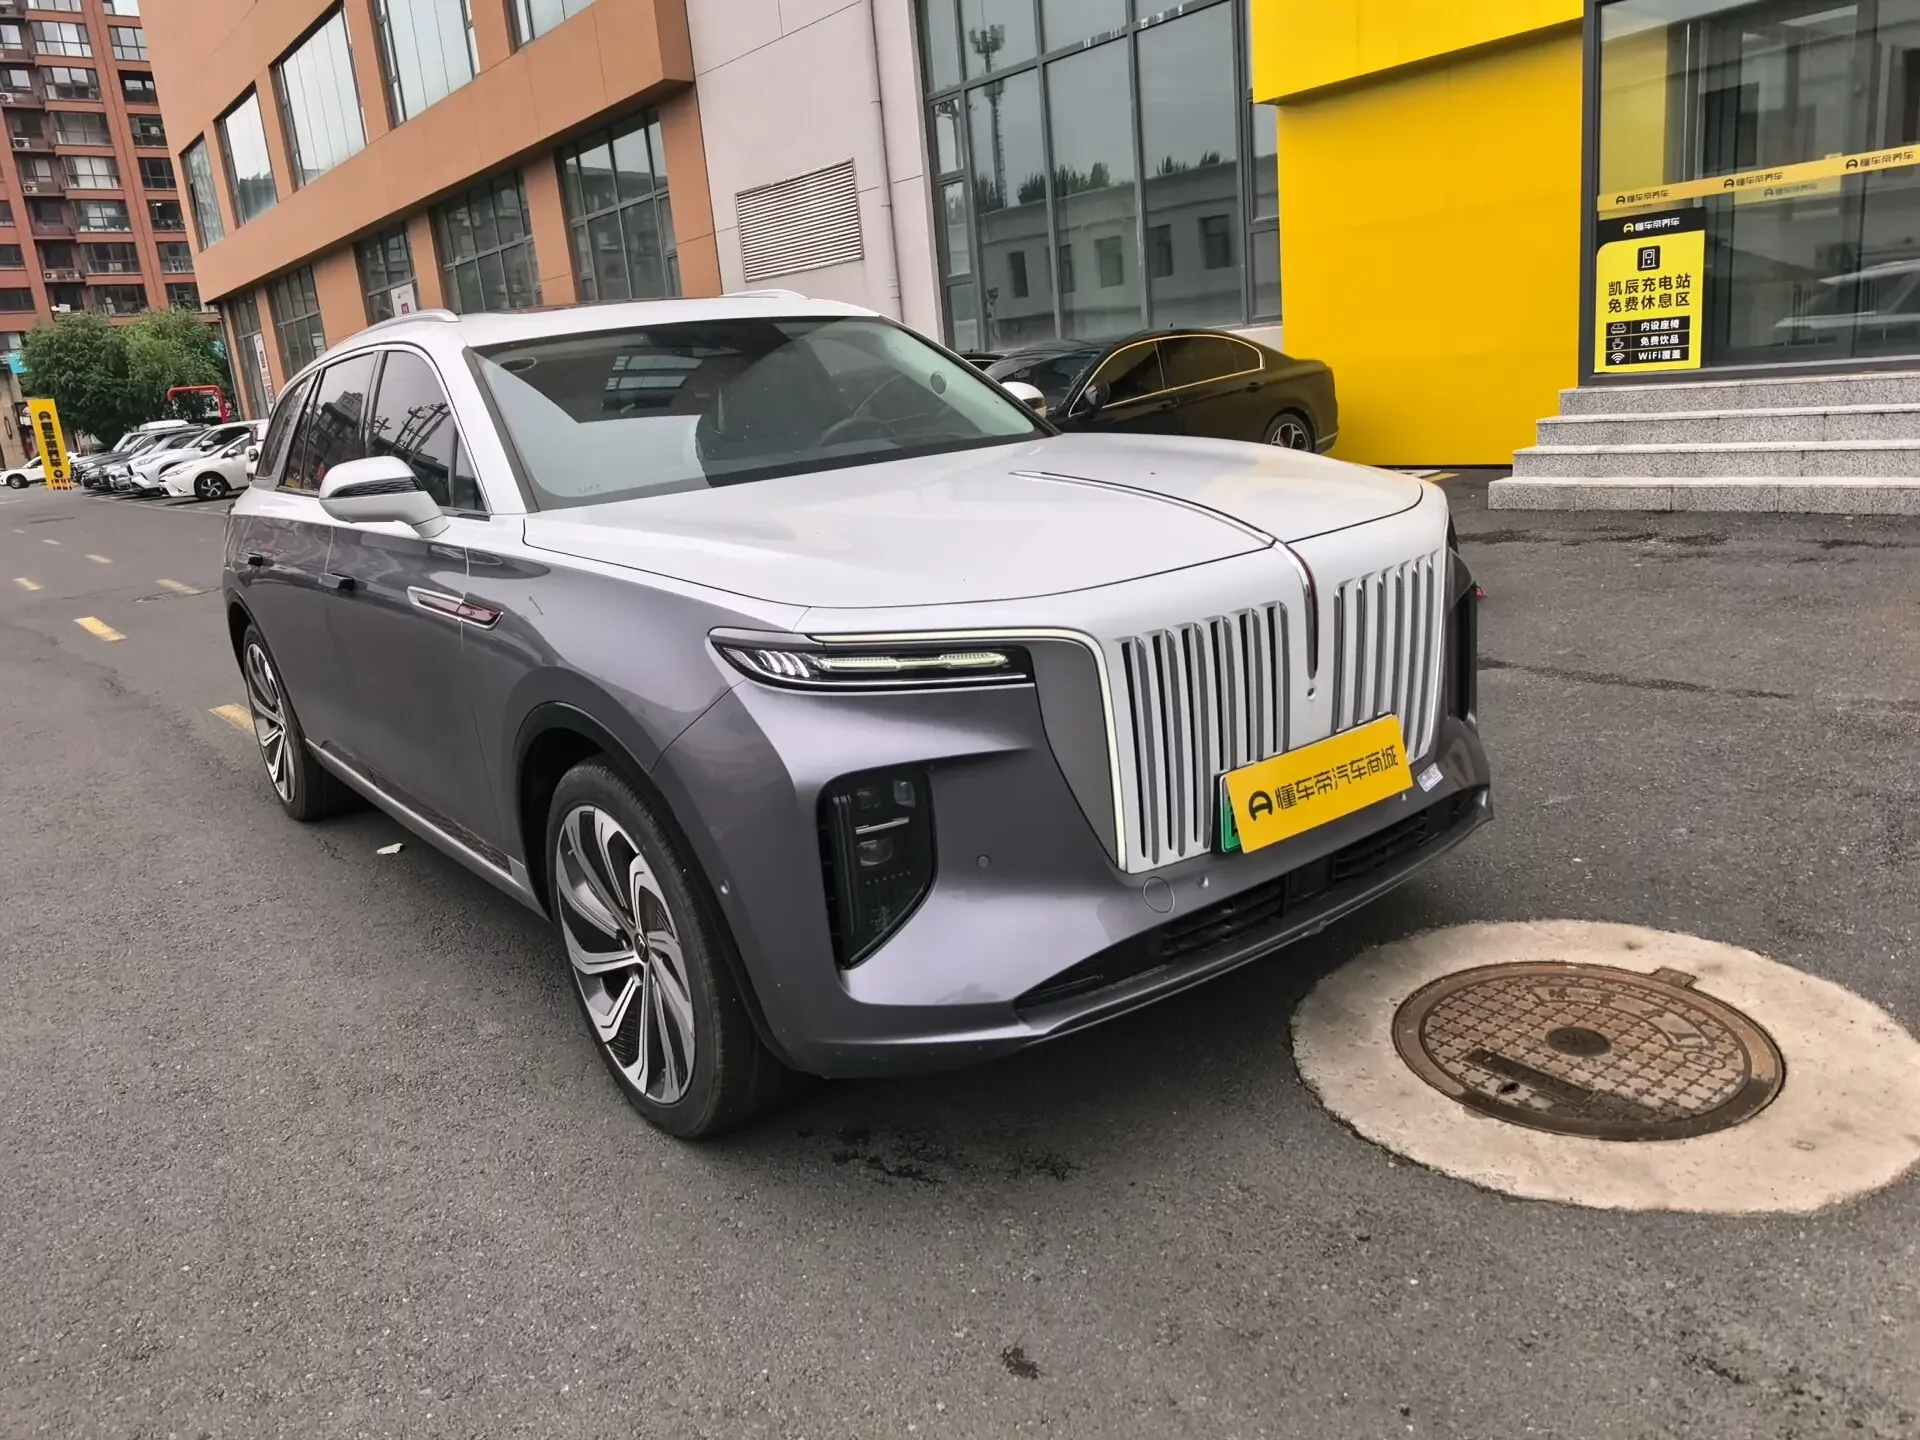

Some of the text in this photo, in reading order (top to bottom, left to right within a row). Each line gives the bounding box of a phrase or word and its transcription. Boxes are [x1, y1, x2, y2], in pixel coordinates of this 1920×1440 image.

[1608, 273, 1691, 296] 凯辰充电站
[1608, 291, 1690, 313] 免费休息区
[1640, 319, 1680, 331] 内设座椅
[1640, 335, 1679, 346] 免费饮品
[1638, 349, 1681, 360] WiFi覆盖
[1275, 745, 1398, 810] 懂车帝汽车商城
